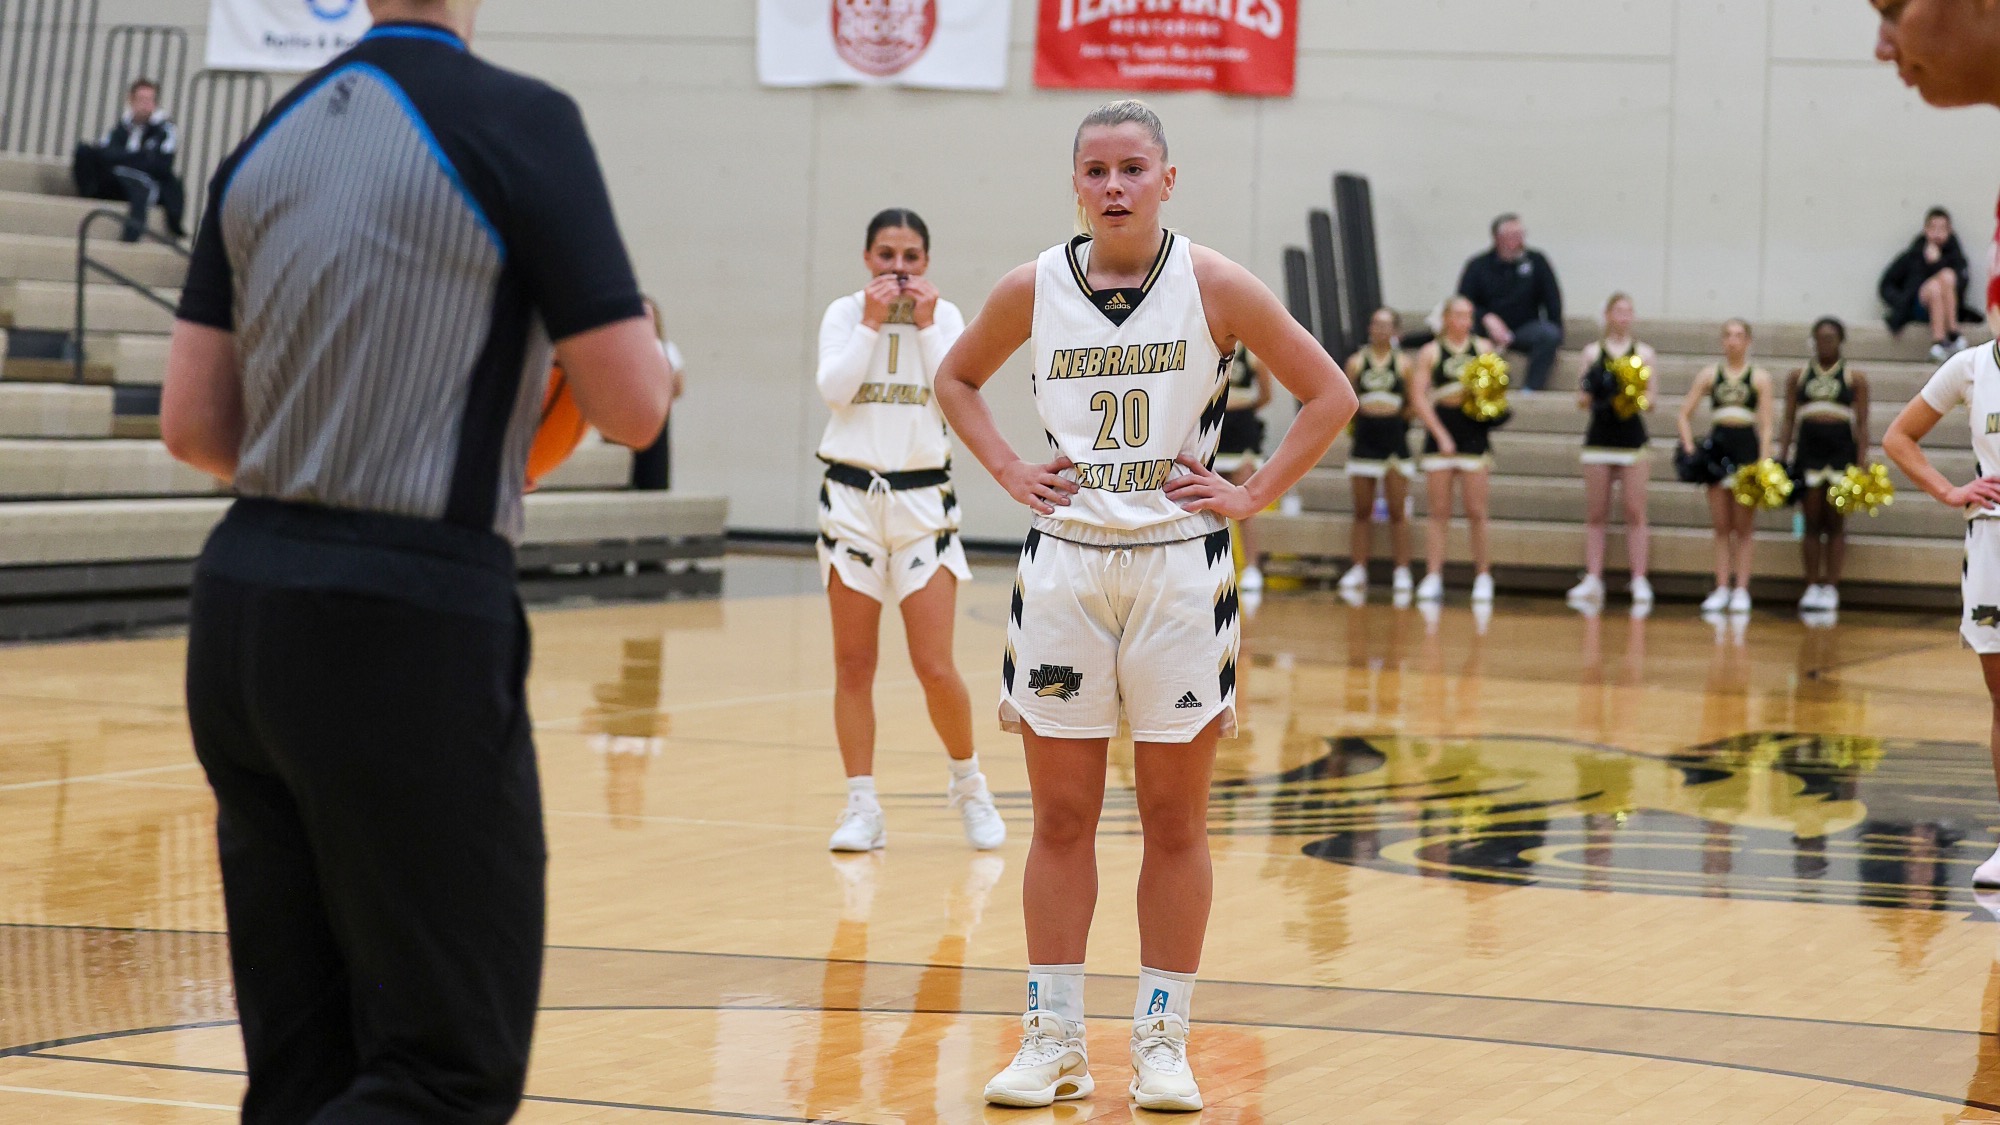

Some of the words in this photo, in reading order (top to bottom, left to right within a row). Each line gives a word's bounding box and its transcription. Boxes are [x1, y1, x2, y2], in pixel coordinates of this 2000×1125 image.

[888, 333, 900, 374] 1
[1047, 340, 1187, 380] NEBRASKA
[1090, 388, 1150, 450] 20
[1028, 664, 1083, 691] NWU
[1174, 701, 1202, 709] adidas
